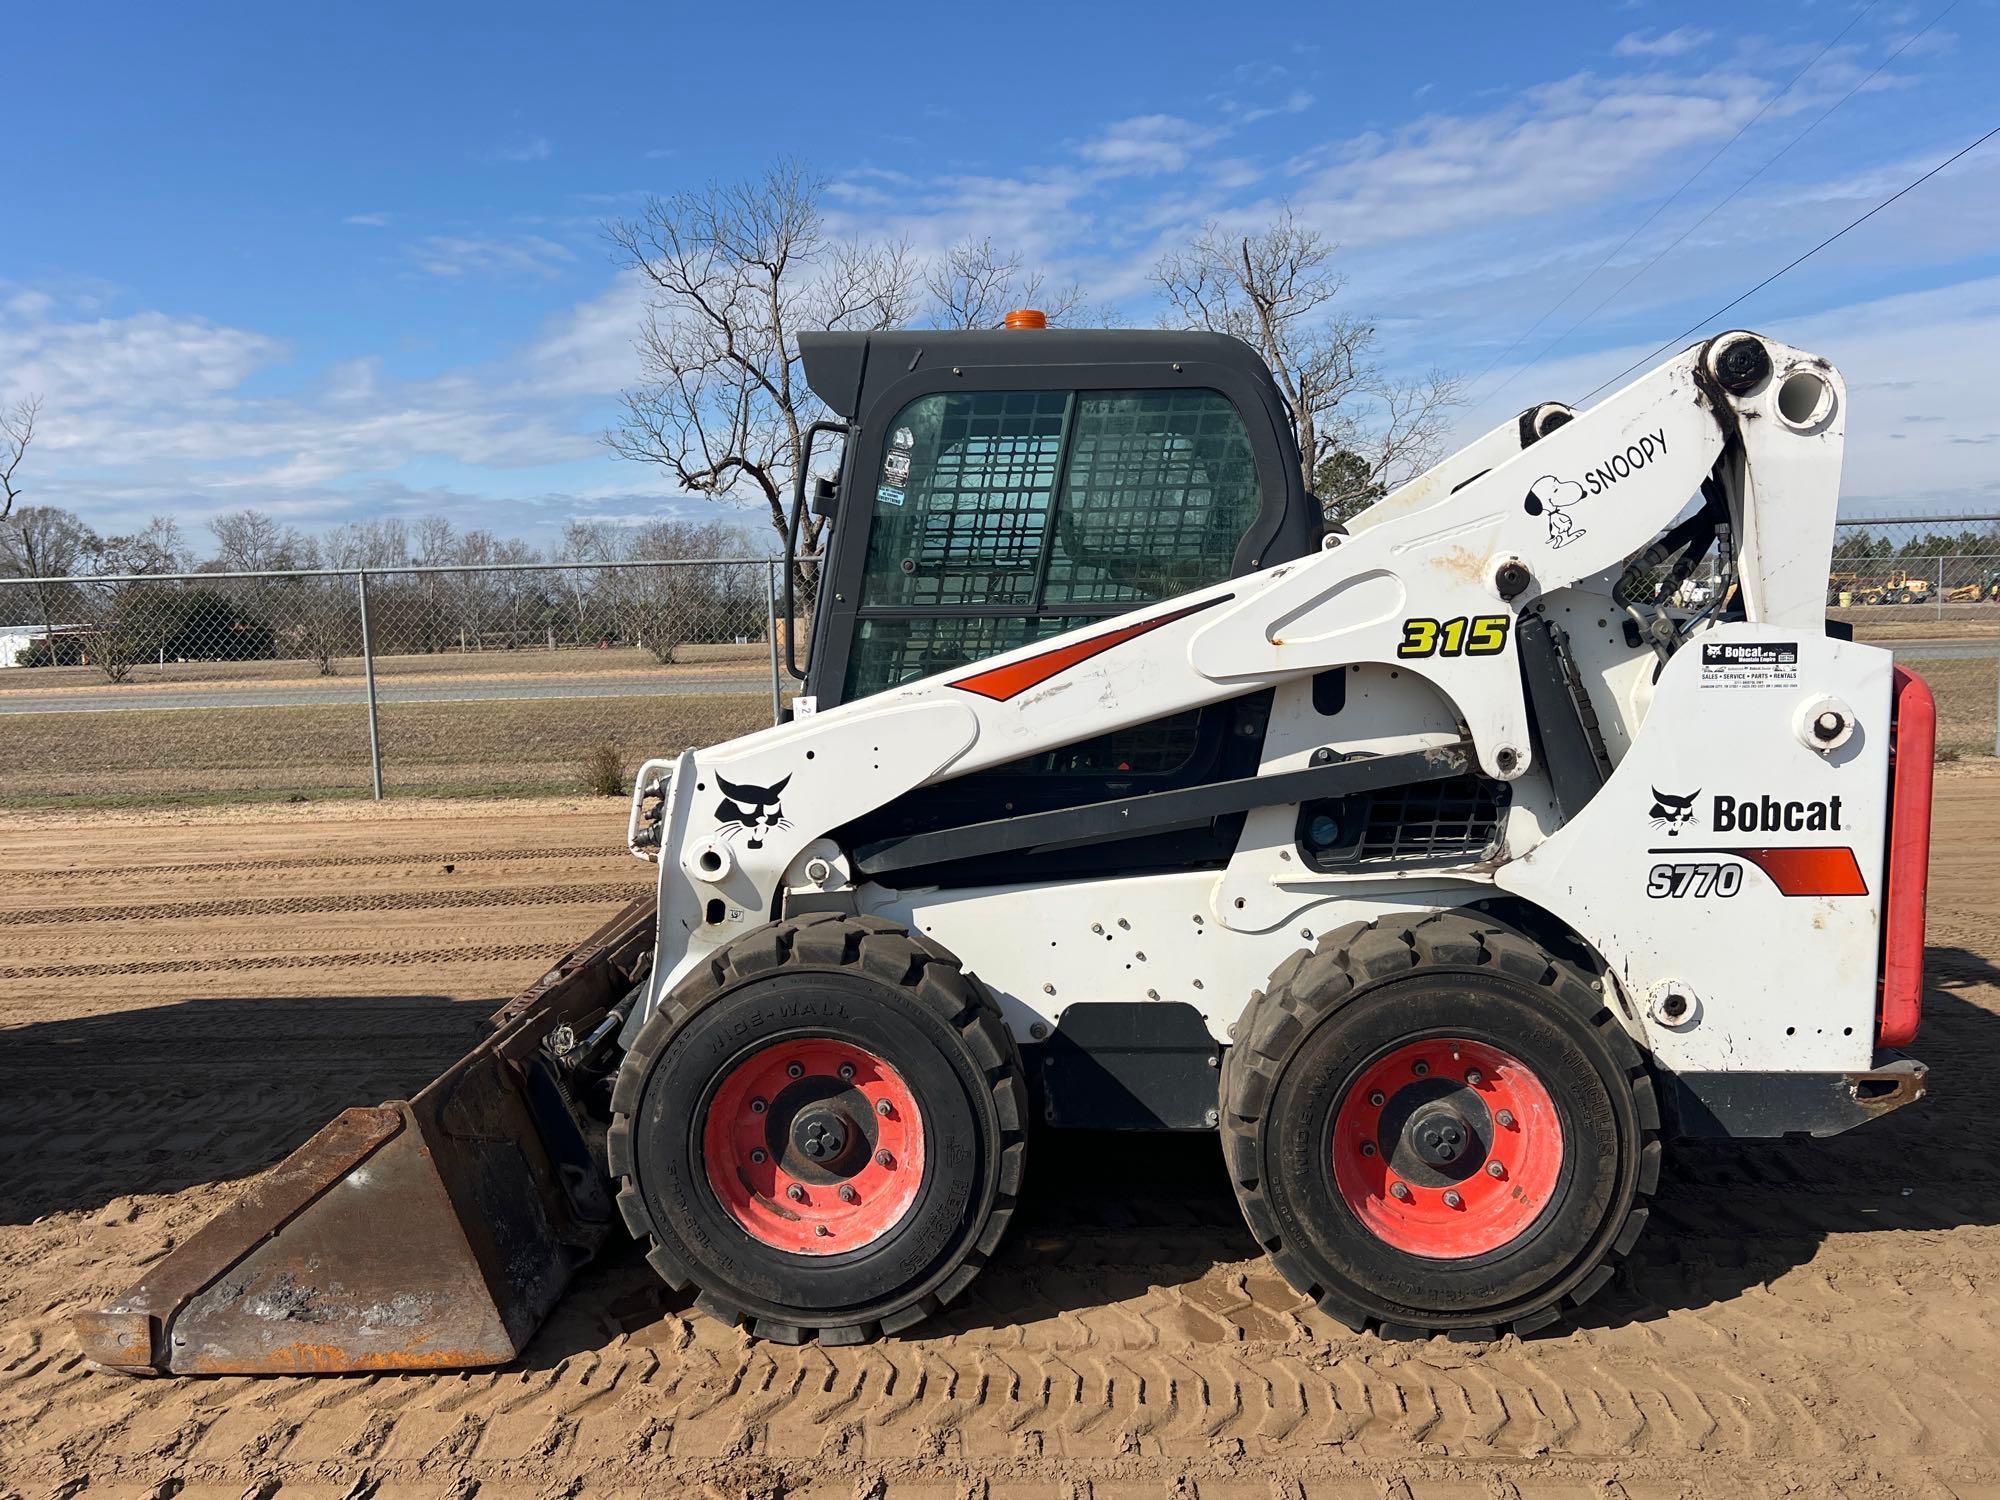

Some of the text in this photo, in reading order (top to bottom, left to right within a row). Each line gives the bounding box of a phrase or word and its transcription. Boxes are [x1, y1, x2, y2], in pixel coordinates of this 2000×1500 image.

[1585, 428, 1667, 495] SNOOPY
[1397, 615, 1510, 659] 315
[1725, 646, 1762, 658] Bobcat
[1713, 795, 1842, 832] Bobcat
[1647, 863, 1743, 898] S770
[1561, 1047, 1616, 1157] HERCULES
